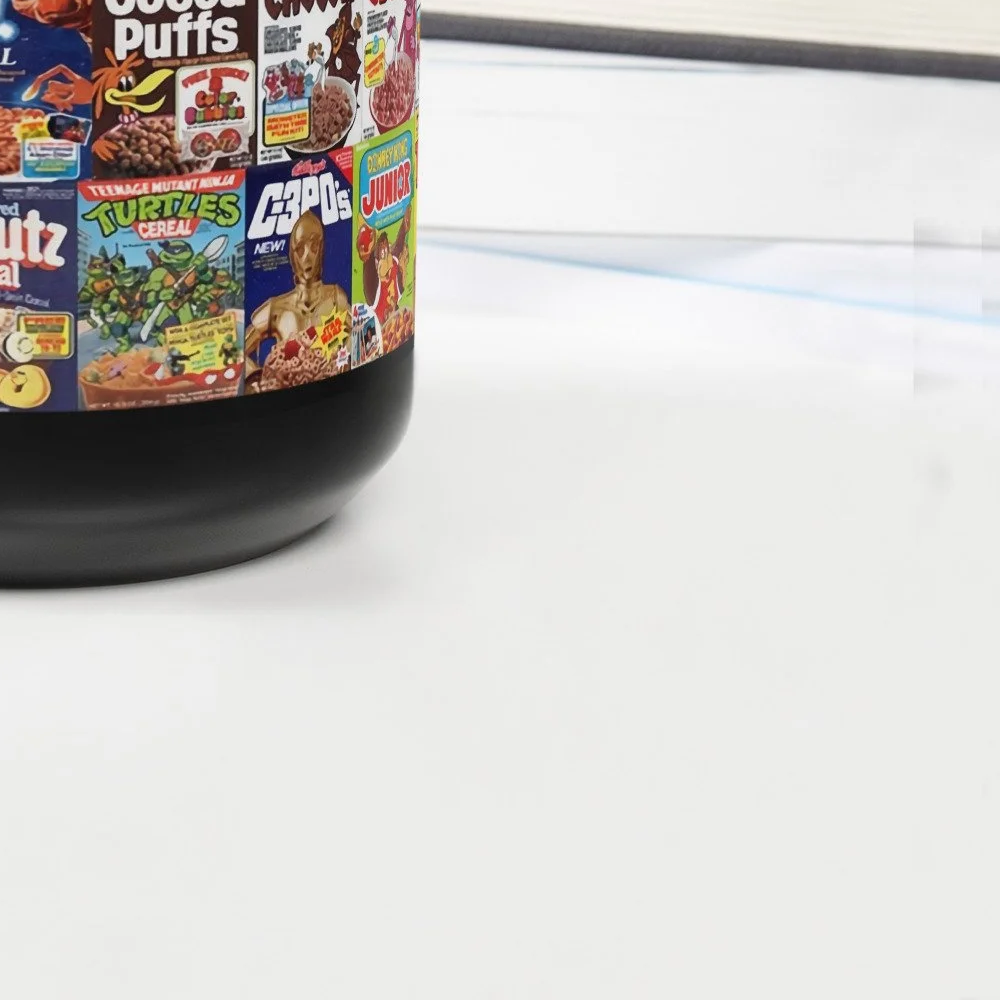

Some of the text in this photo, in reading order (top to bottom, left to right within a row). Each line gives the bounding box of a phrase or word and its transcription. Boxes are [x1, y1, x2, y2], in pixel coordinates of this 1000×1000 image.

[114, 10, 239, 61] Puffs
[88, 174, 237, 197] TEENAGE MUTANT NINJA
[362, 160, 411, 217] JUNIOR
[82, 190, 241, 237] TURTLES
[138, 221, 192, 239] CEREAL
[254, 239, 286, 255] NEW!
